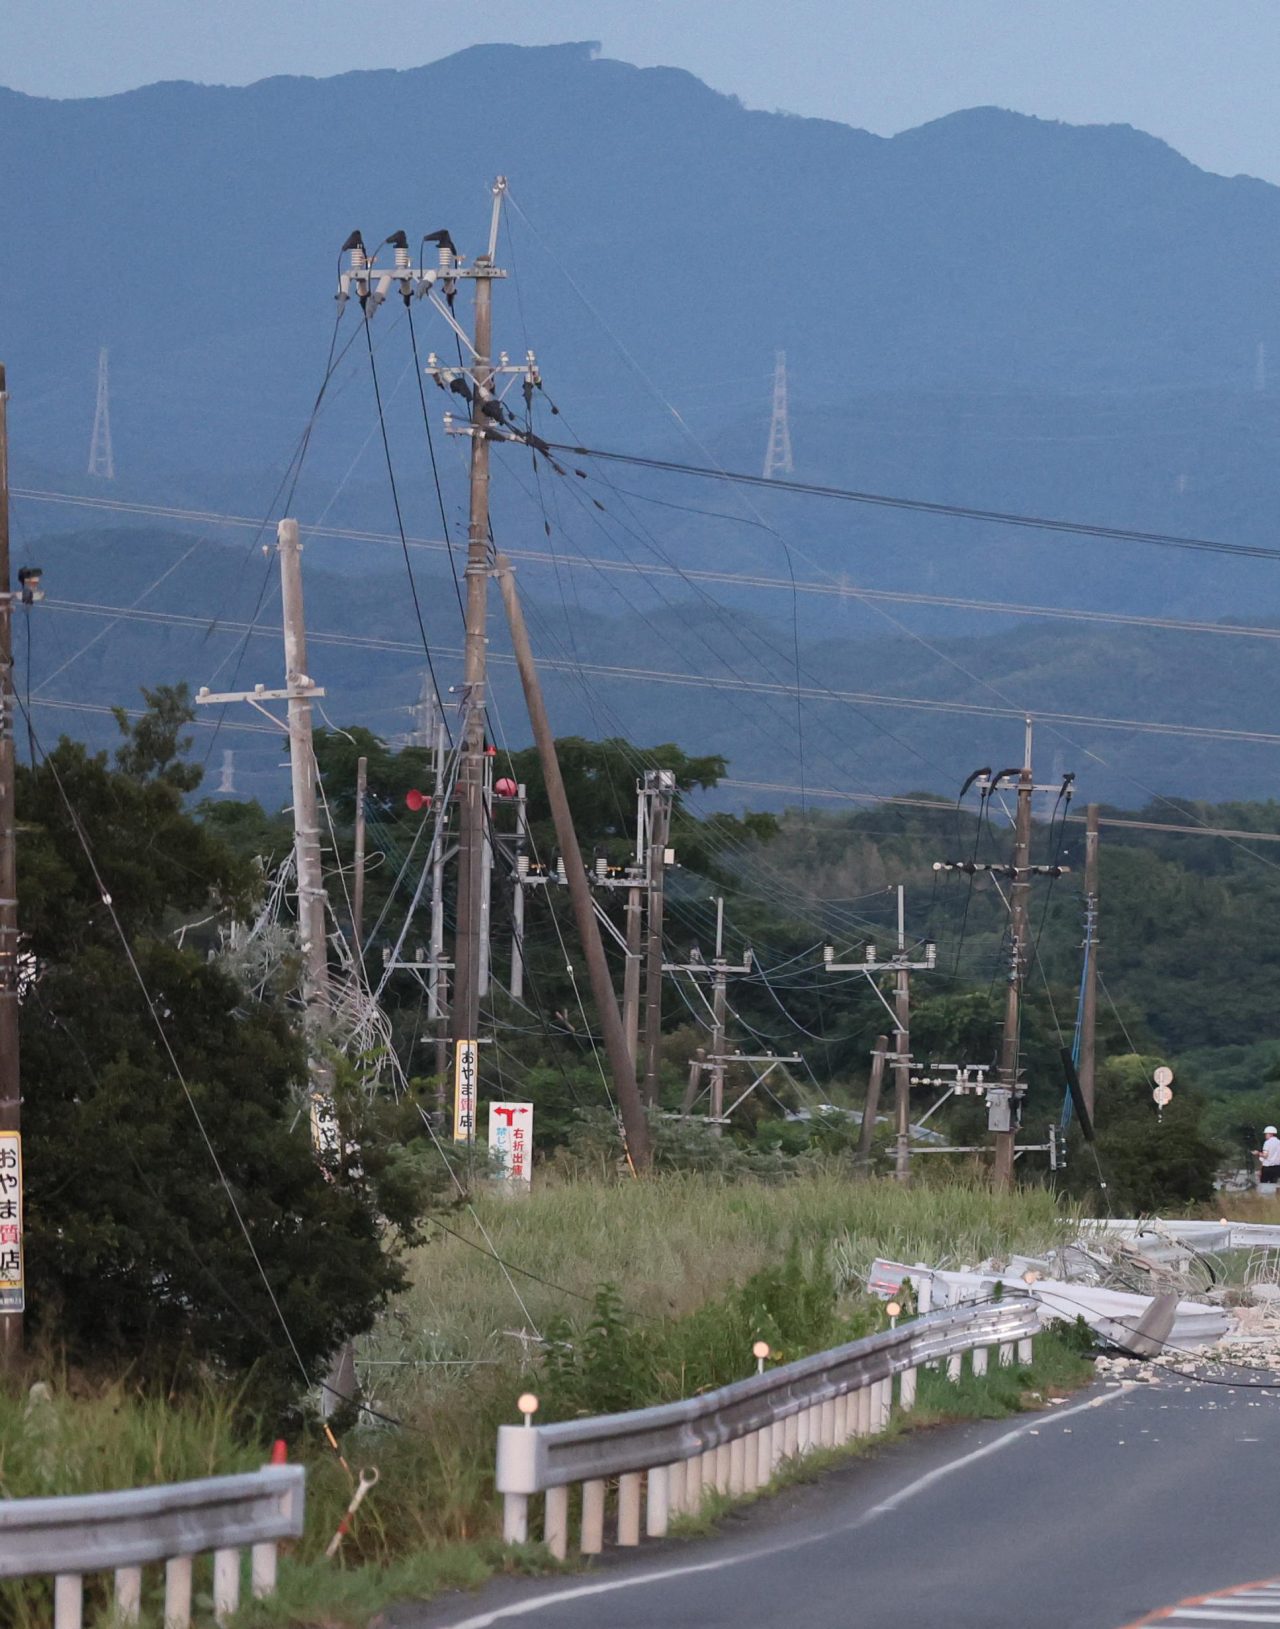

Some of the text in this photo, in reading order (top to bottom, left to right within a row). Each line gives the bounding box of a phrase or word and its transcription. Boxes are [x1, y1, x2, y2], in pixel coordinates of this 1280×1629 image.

[460, 1051, 474, 1128] おやま質店
[0, 1149, 20, 1271] おやま質店
